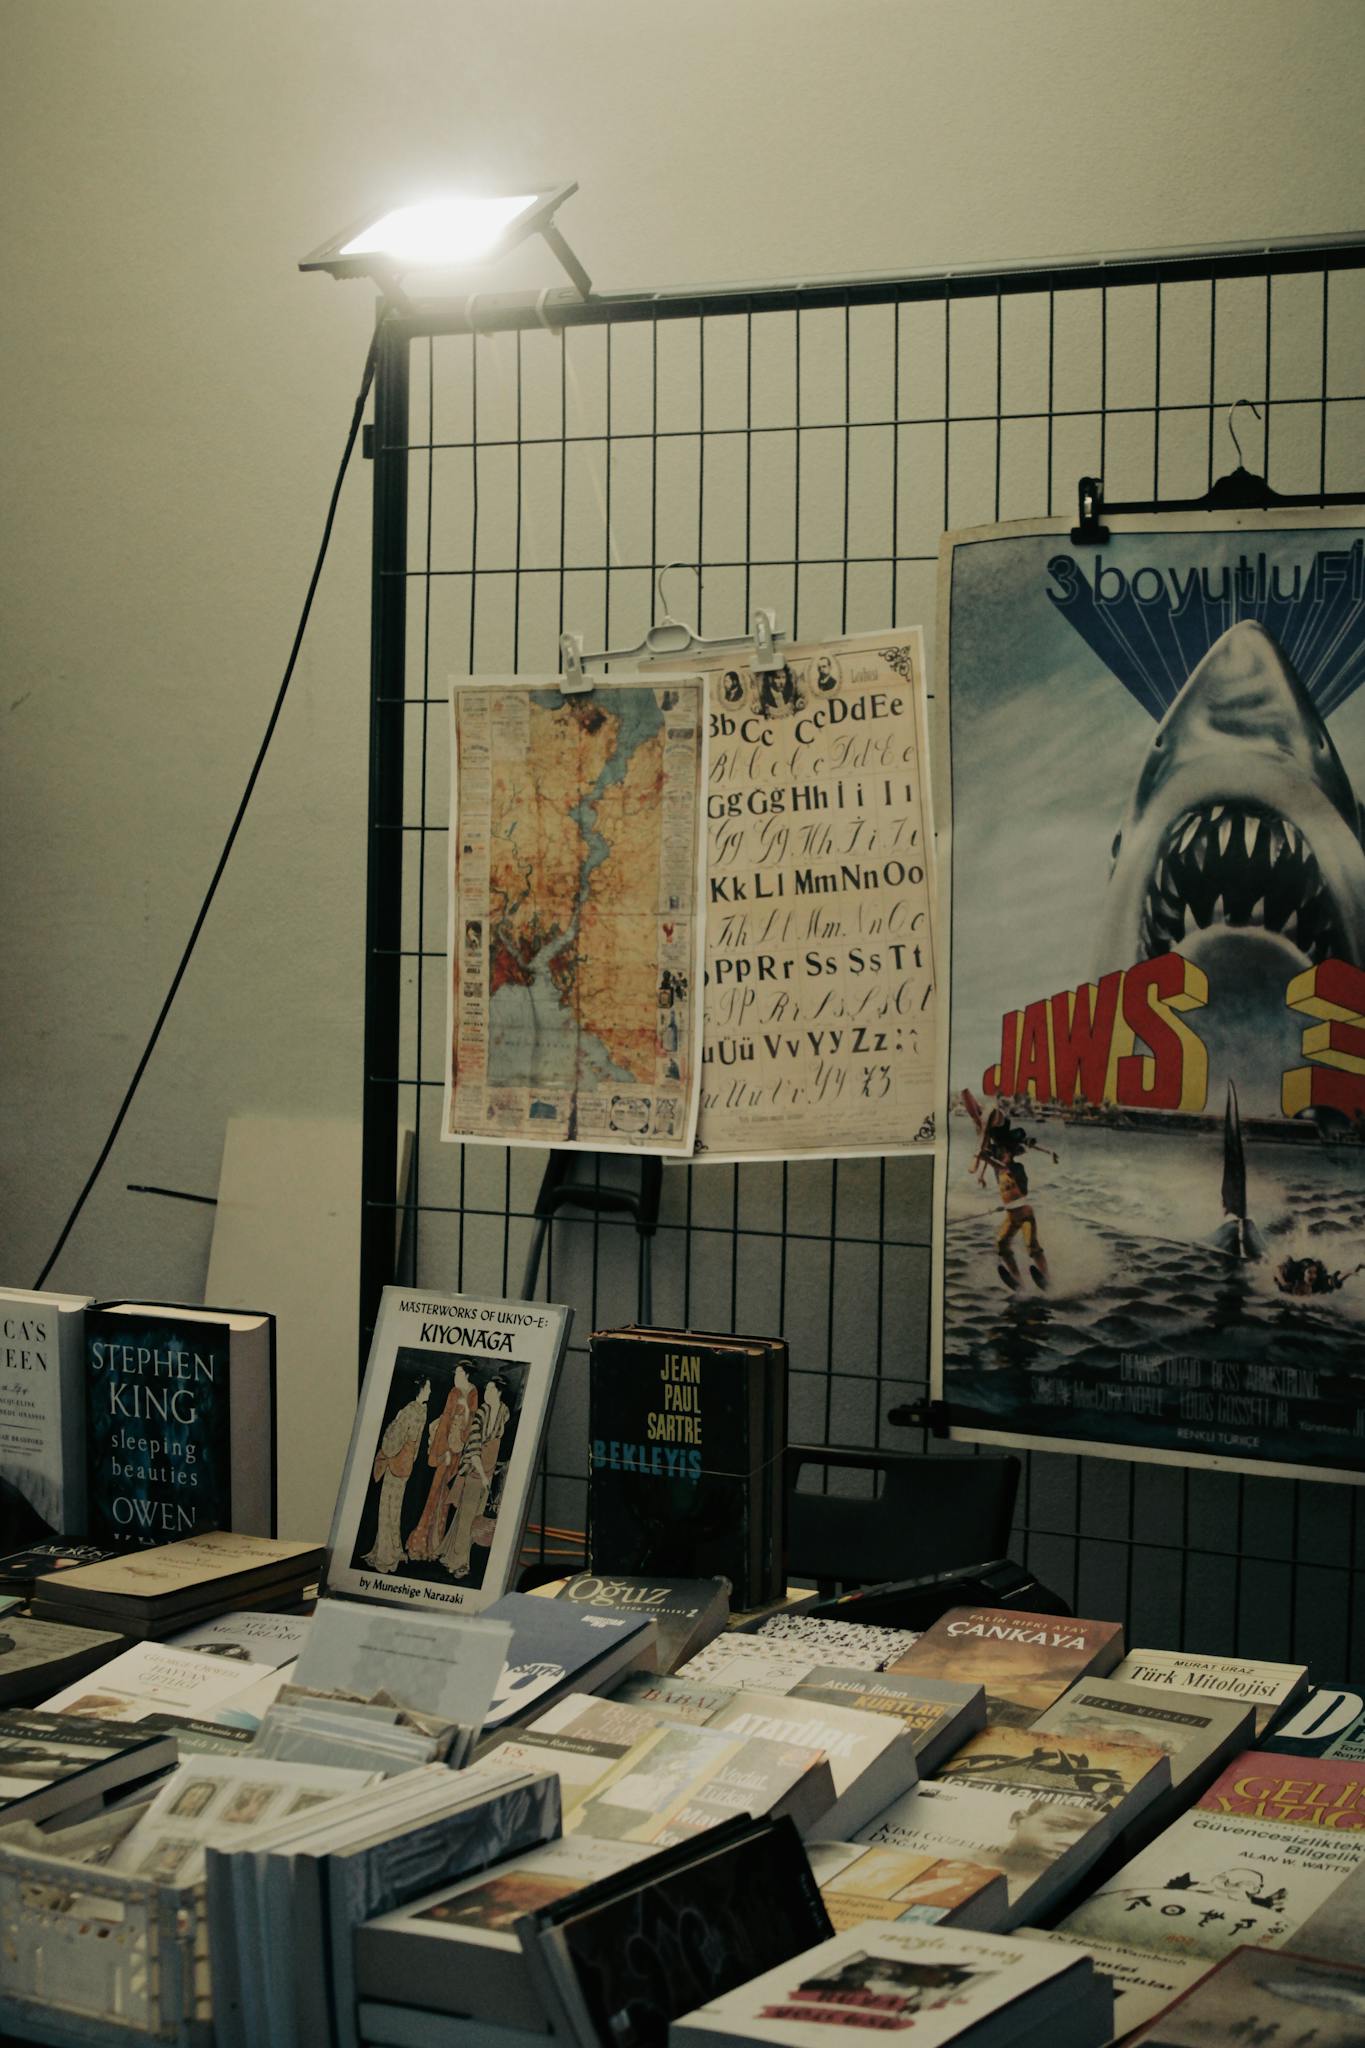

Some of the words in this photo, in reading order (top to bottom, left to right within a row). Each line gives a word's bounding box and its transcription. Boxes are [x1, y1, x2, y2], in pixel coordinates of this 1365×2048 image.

[1046, 555, 1079, 604] 3
[1094, 552, 1301, 616] boyutlu
[983, 951, 1208, 1112] JAWS
[400, 1300, 477, 1321] MASTERWORKS
[480, 1311, 496, 1322] OF
[497, 1312, 549, 1328] UKIYO-E:
[420, 1323, 515, 1353] KIYONAGA
[0, 1347, 48, 1372] EEN
[92, 1342, 215, 1382] STEPHEN
[660, 1354, 700, 1384] JEAN
[110, 1382, 197, 1425] KING
[664, 1384, 701, 1414] PAUL
[647, 1412, 702, 1445] SARTRE
[111, 1429, 196, 1464] sleeping
[112, 1457, 198, 1486] beauties
[113, 1497, 196, 1532] OWEN
[359, 1576, 370, 1590] by
[373, 1578, 421, 1599] Muneshige
[423, 1587, 464, 1606] Narazaki
[569, 1578, 672, 1607] Oğuz
[686, 1609, 699, 1618] 2
[945, 1621, 1086, 1652] ÇANKAYA
[1129, 1665, 1177, 1687] Türk
[1181, 1669, 1280, 1698] Mitolojisi
[1174, 1660, 1220, 1671] MURAT
[1223, 1665, 1255, 1675] URAZ
[725, 1713, 868, 1759] ATATÜRK
[675, 1807, 724, 1827] Mav
[1238, 1850, 1278, 1864] ALAN
[1302, 1860, 1352, 1874] WATTS
[1284, 1844, 1361, 1863] Bilgelik
